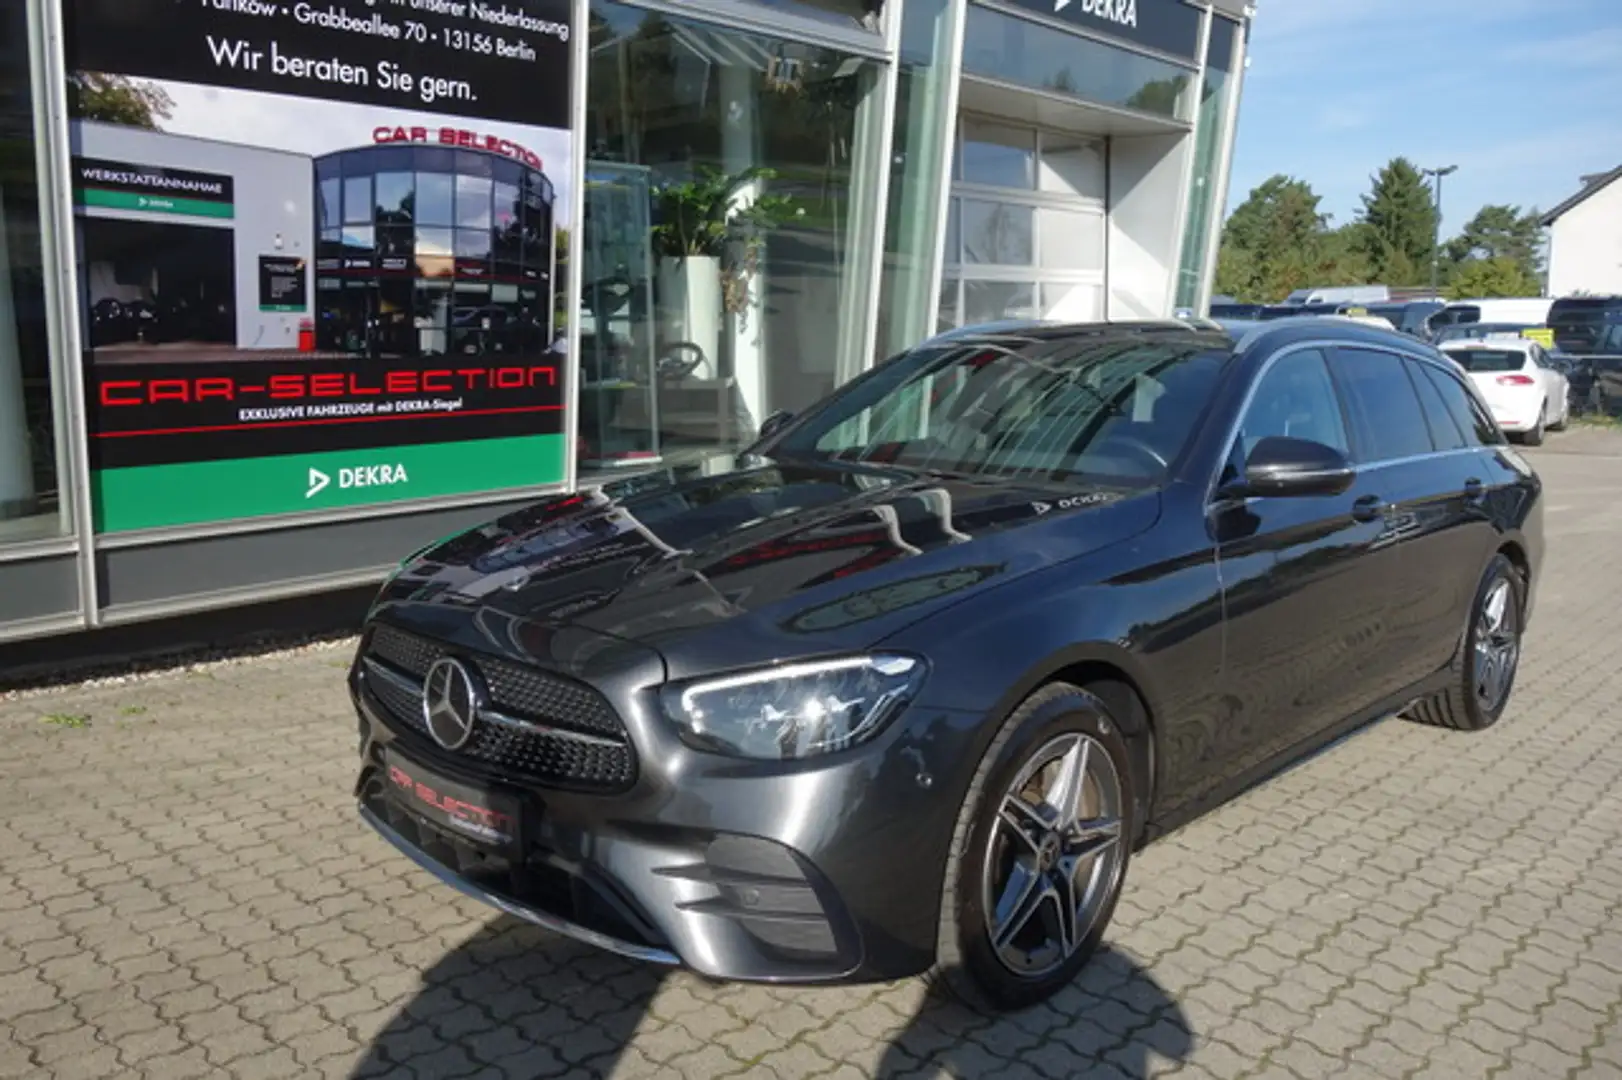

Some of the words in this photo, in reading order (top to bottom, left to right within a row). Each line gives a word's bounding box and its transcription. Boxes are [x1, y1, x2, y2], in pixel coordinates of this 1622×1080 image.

[202, 0, 277, 16] ankow
[294, 3, 400, 38] Grabbeallee
[404, 20, 427, 42] 70
[444, 28, 492, 54] 13156
[496, 38, 536, 62] Berlin
[469, 2, 569, 41] Niederlassung
[206, 35, 263, 70] Wir
[271, 41, 369, 86] beraten
[376, 61, 413, 91] Sie
[420, 75, 478, 102] gern.
[373, 126, 427, 143] CAR
[81, 168, 223, 194] WERKSTATTANNAHME
[101, 366, 556, 406] CAR-SELECTION
[238, 405, 304, 421] EXKLUSIVE
[306, 401, 374, 417] FAHRZEUGE
[376, 402, 393, 412] mit
[395, 397, 463, 412] DEKRA-Siegel
[338, 463, 409, 489] DEKRA
